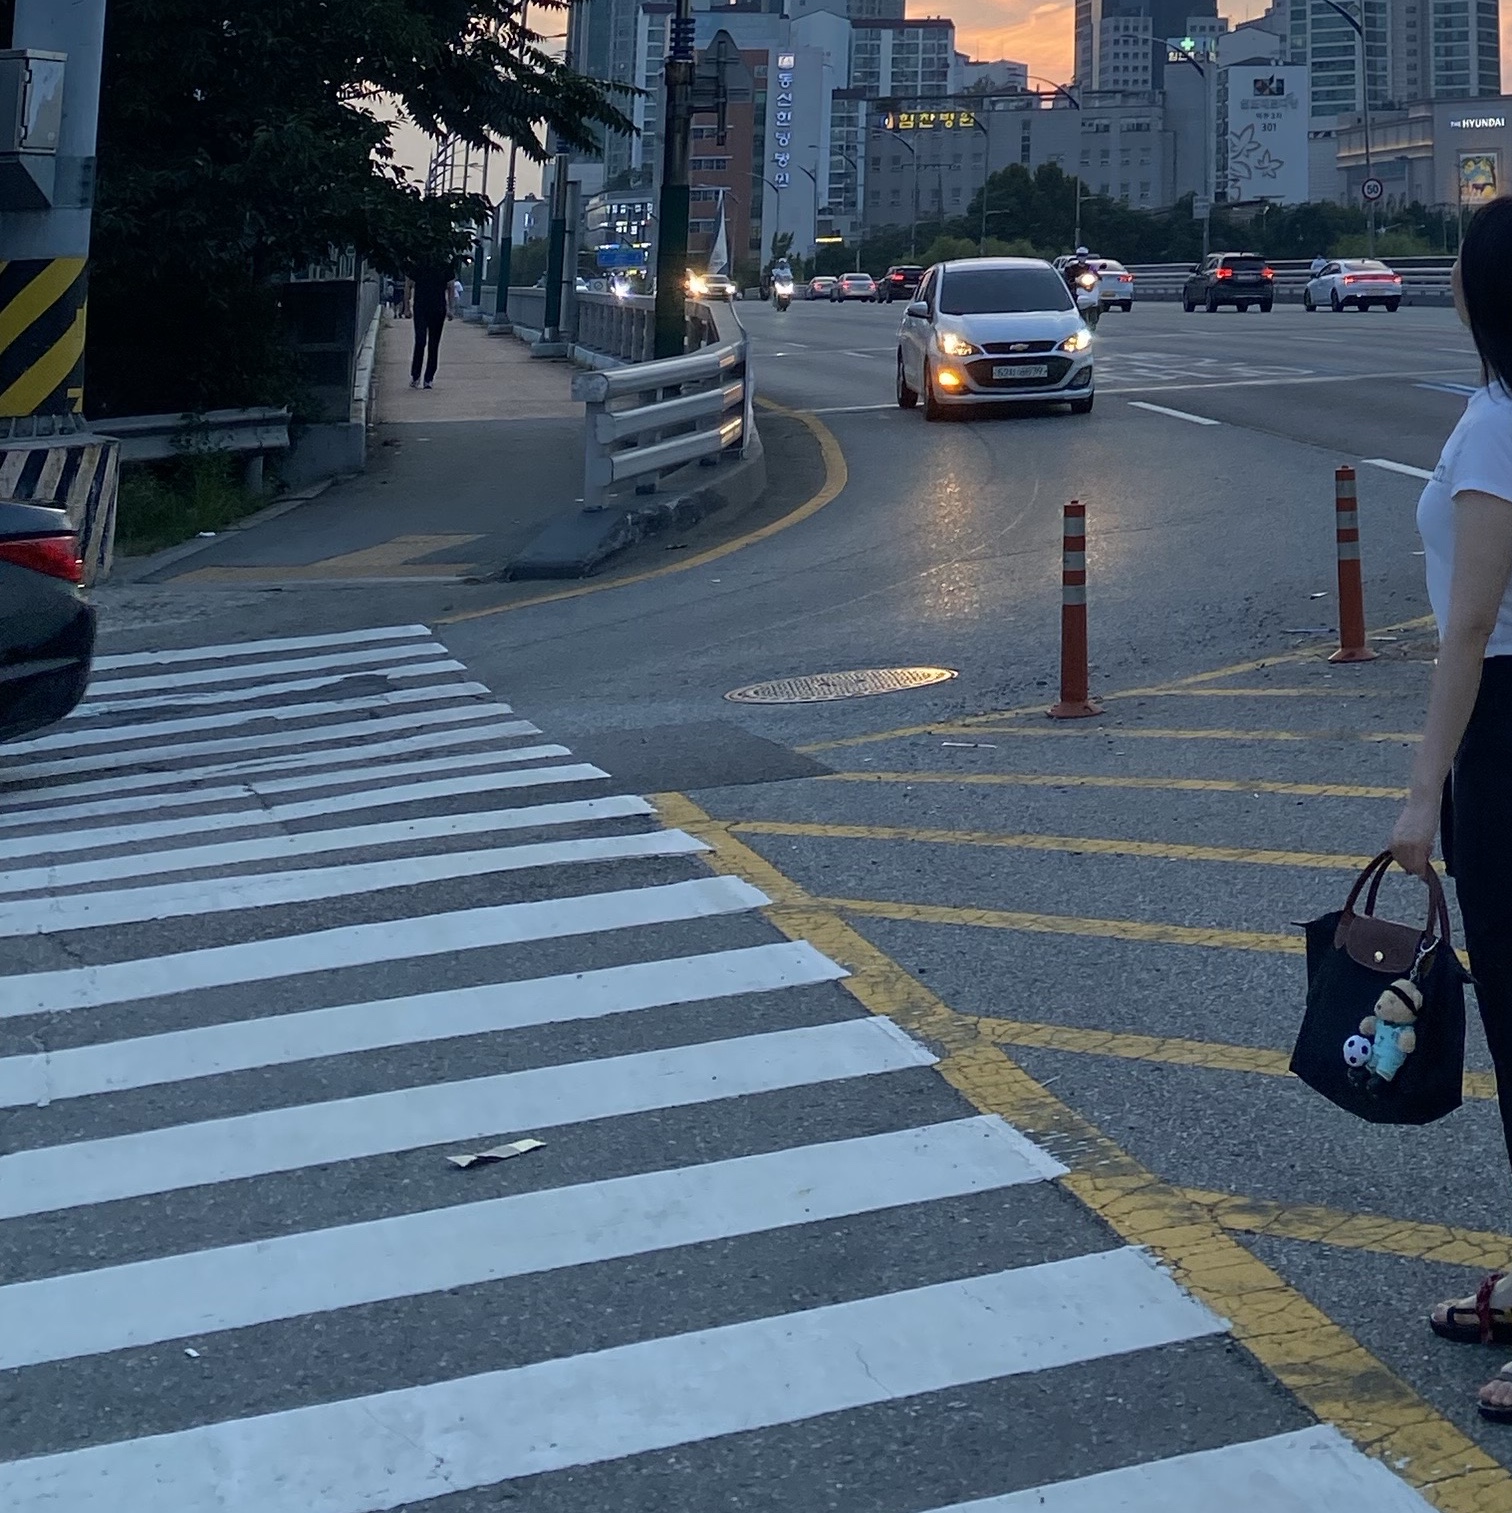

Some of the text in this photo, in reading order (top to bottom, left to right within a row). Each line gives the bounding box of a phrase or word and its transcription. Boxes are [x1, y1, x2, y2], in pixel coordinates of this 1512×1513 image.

[899, 112, 975, 129] 힘찬병원
[1462, 118, 1505, 128] HYUNDAI
[775, 72, 793, 188] 동신한방병원
[1261, 122, 1277, 132] 301
[1367, 184, 1379, 194] 50
